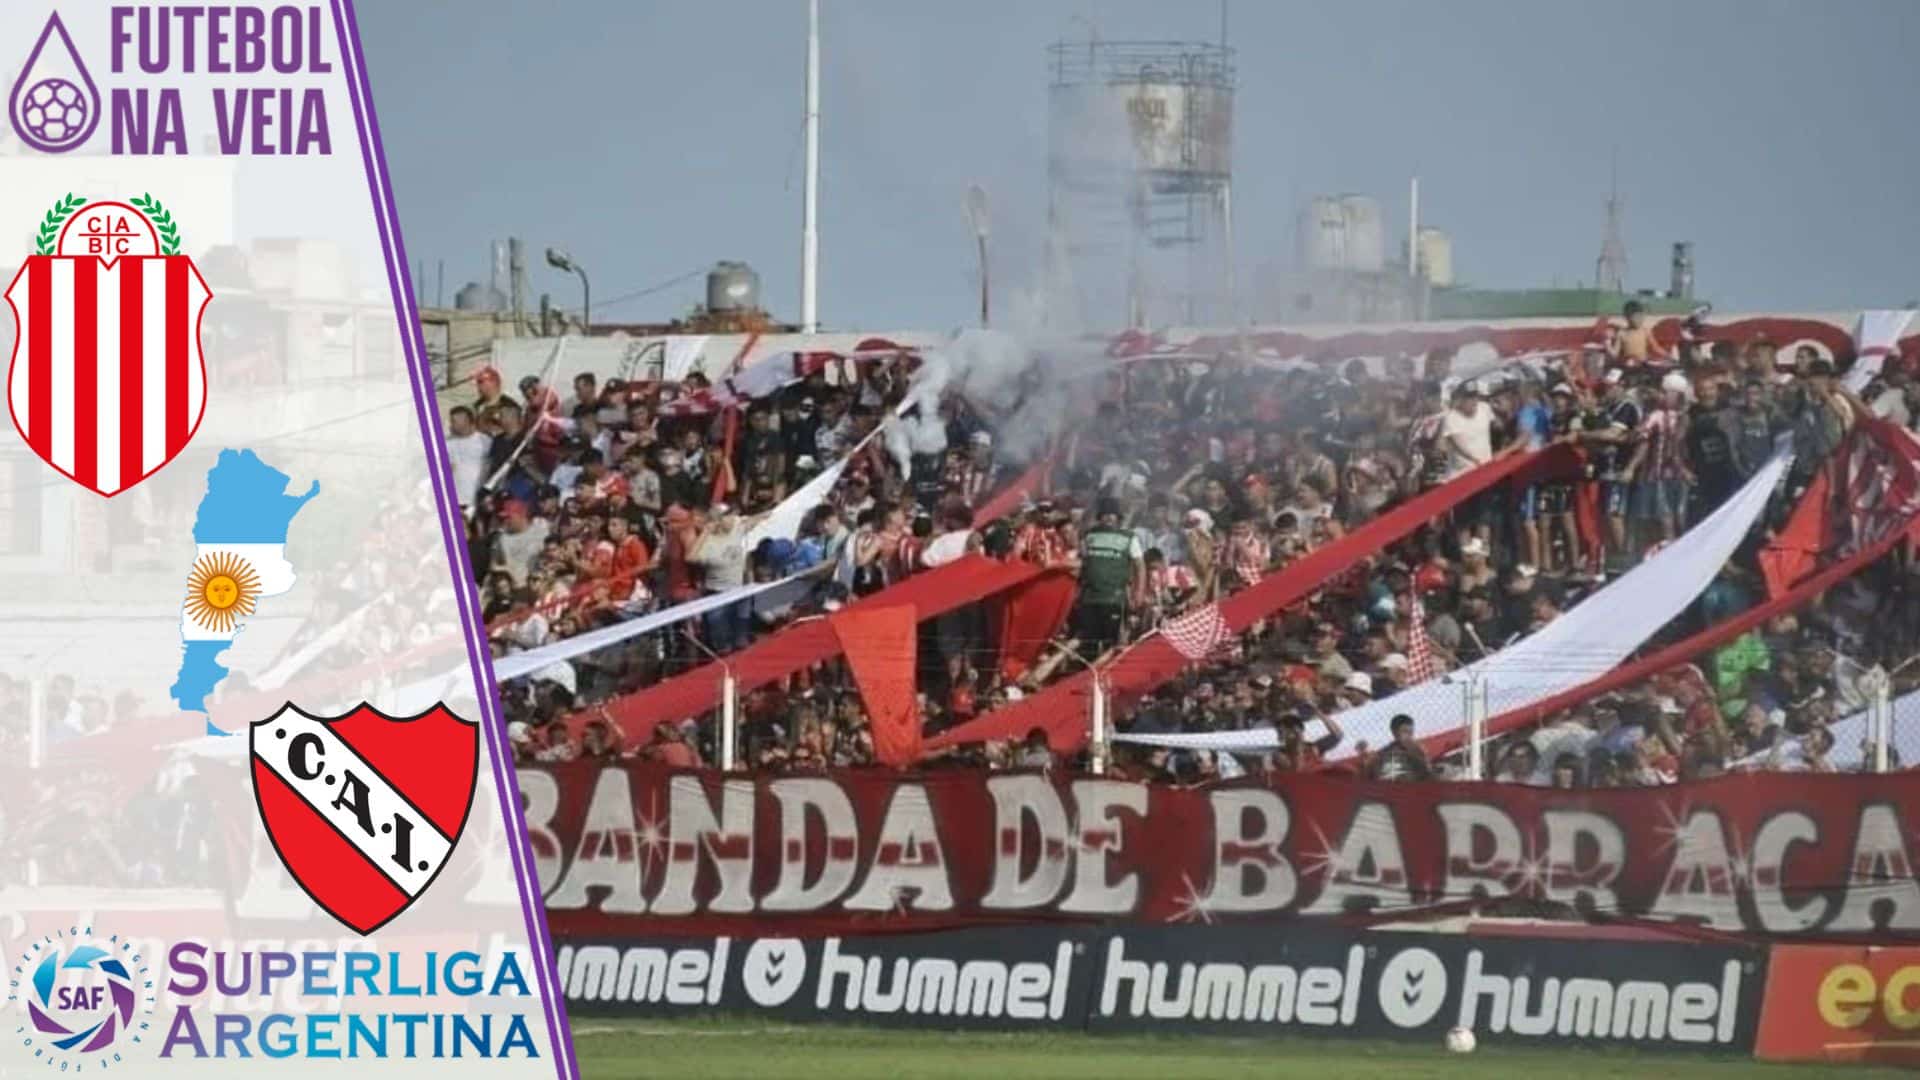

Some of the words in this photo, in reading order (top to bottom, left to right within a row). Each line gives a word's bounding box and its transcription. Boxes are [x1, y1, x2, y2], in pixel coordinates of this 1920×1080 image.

[515, 767, 953, 914] BANDA
[980, 775, 1150, 913] DE
[816, 937, 1073, 1021] hummel
[1100, 935, 1366, 1026] hummel
[1457, 949, 1742, 1043] hummel
